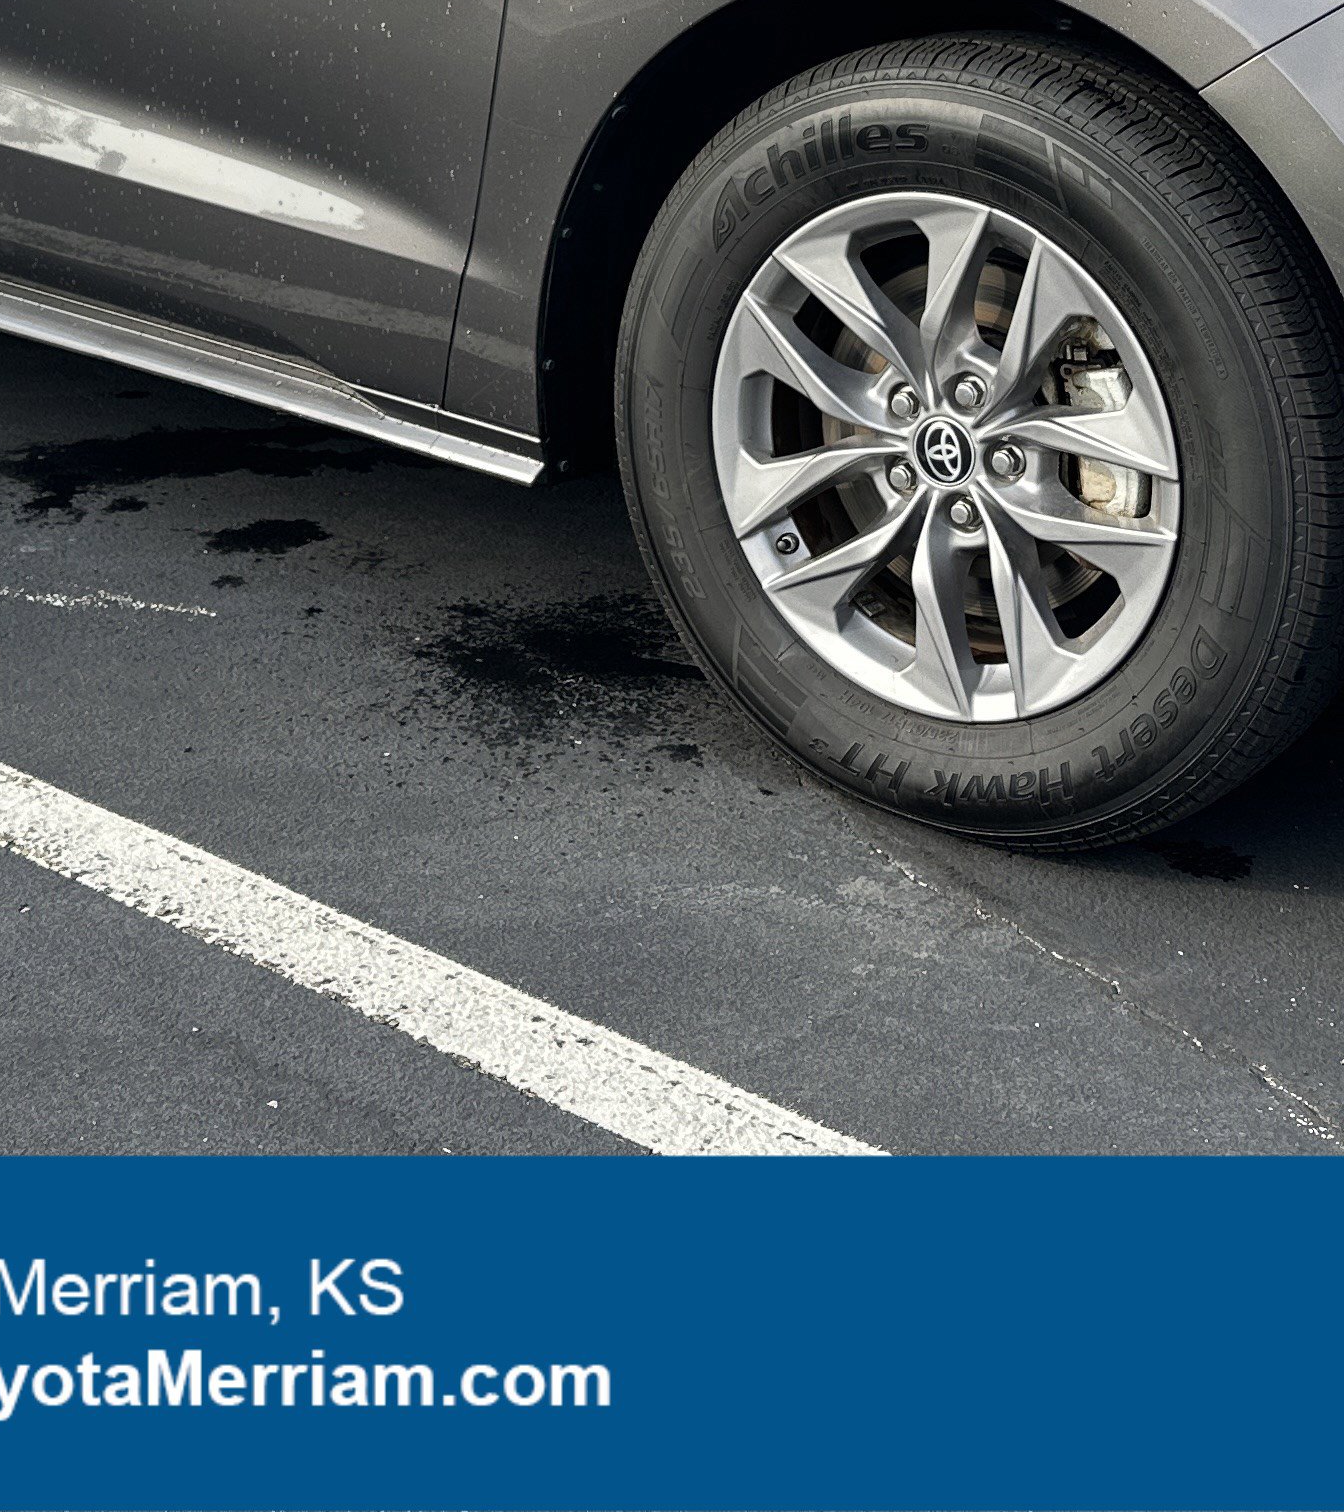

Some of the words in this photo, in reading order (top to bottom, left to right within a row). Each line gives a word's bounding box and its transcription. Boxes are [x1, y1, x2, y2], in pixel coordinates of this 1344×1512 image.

[712, 114, 930, 253] Achilles
[644, 373, 707, 600] 235/65R17
[1091, 624, 1228, 783] Desert
[923, 760, 1074, 806] Hawk
